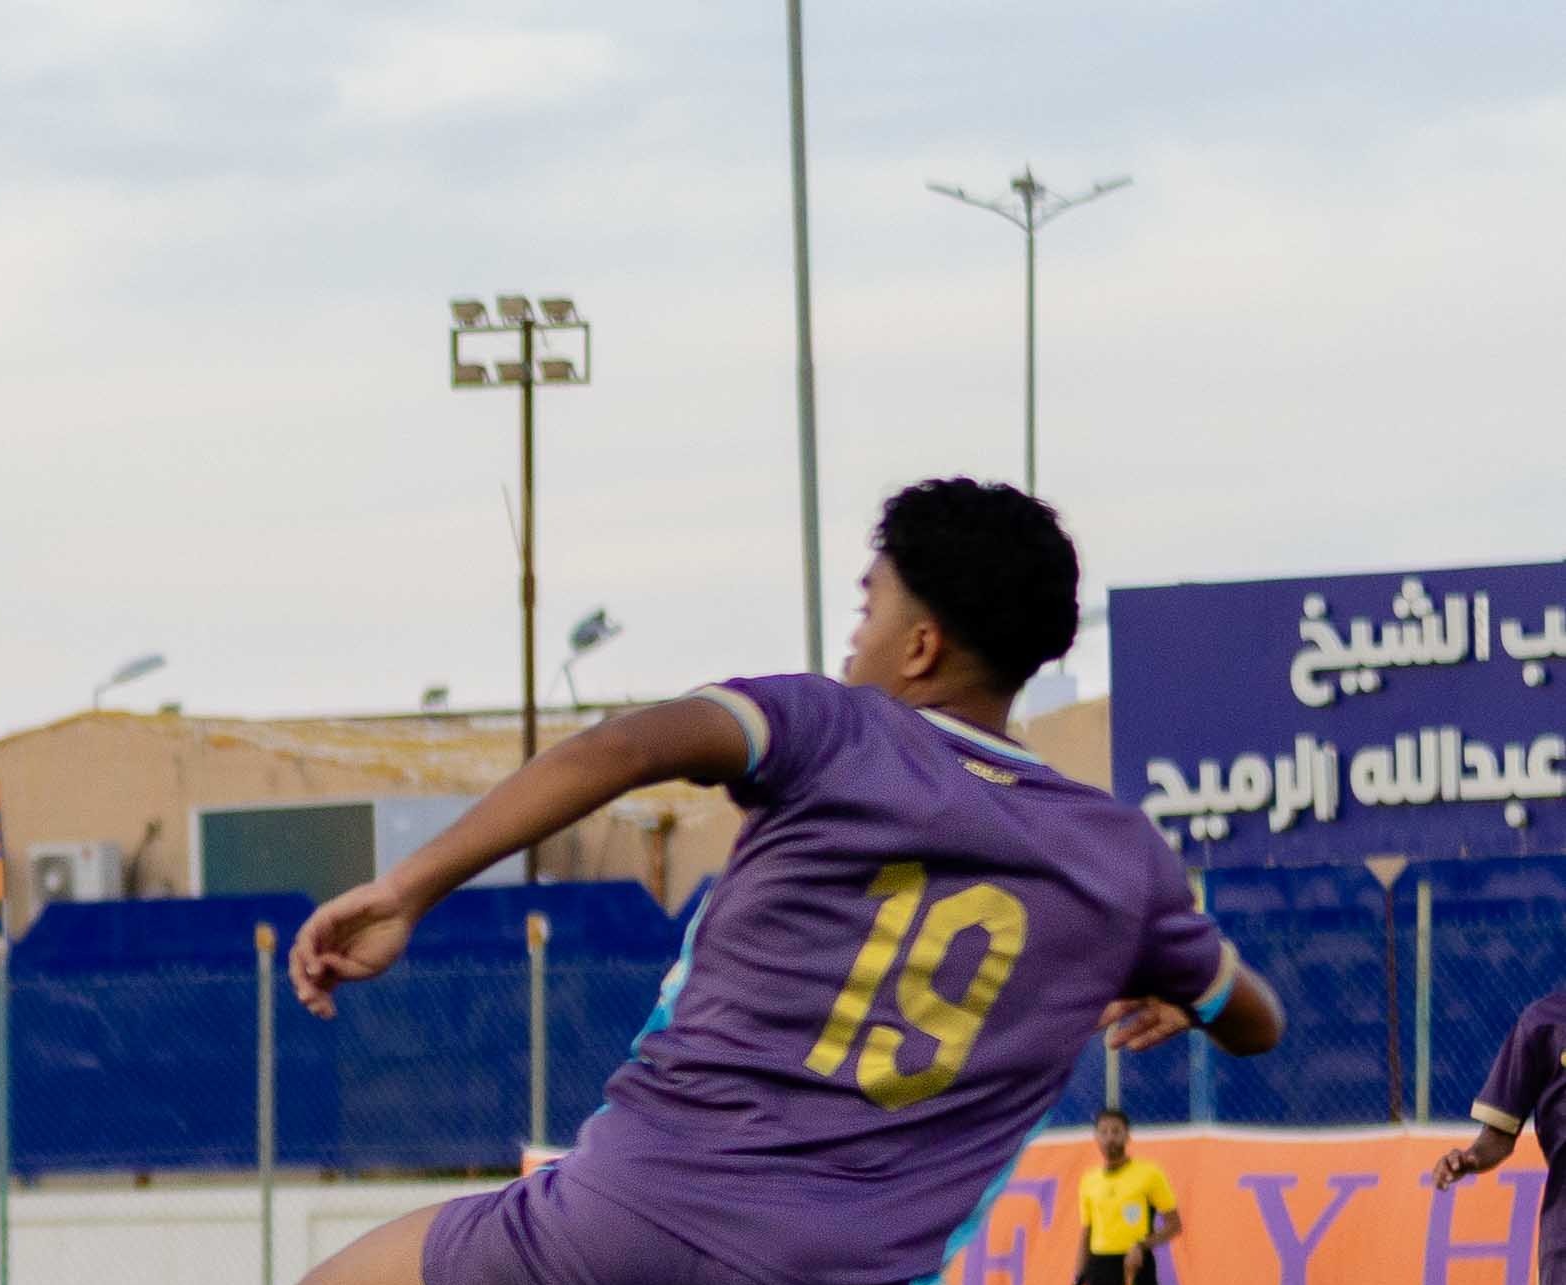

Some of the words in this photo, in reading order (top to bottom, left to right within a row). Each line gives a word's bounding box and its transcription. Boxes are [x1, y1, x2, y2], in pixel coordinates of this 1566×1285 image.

[1290, 576, 1490, 707] الشيخ
[1350, 726, 1566, 828] عبدالله
[803, 861, 1027, 1112] 19
